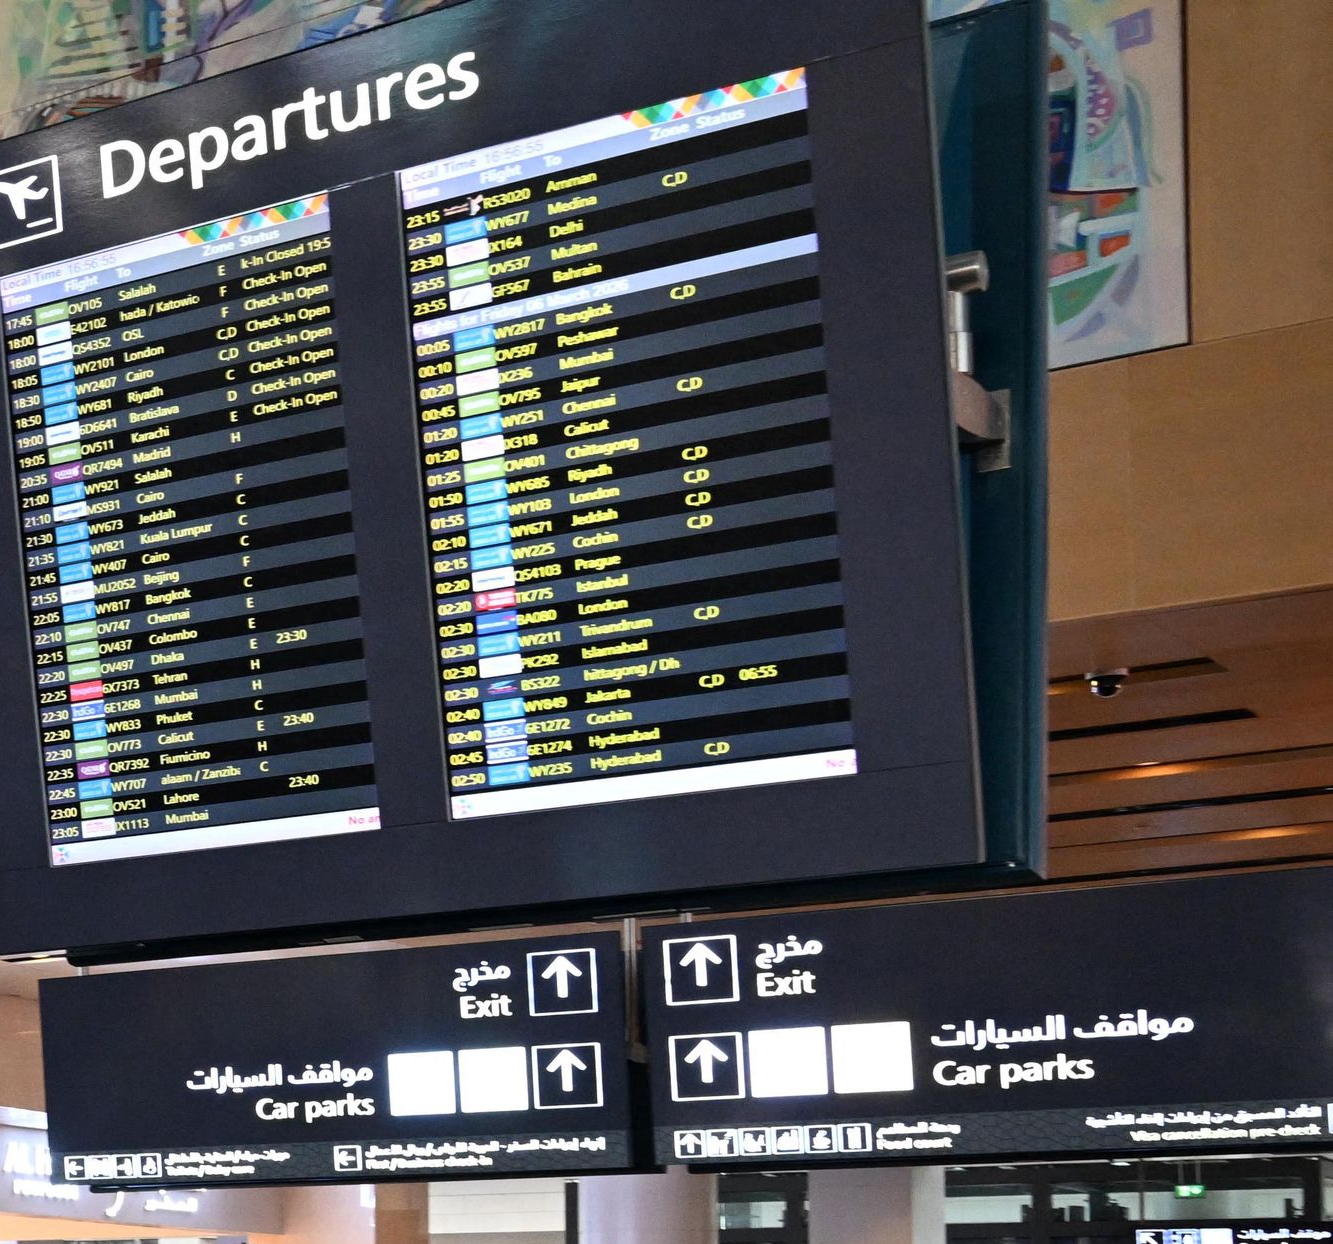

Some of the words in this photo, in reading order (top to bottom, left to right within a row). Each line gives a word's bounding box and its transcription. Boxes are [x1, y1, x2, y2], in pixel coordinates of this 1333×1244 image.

[100, 51, 480, 199] Departures
[63, 273, 98, 294] Flight
[116, 265, 131, 280] To
[202, 238, 235, 258] Zone
[238, 227, 280, 249] Status
[11, 374, 38, 389] 18:05
[73, 356, 114, 374] WY2101
[123, 346, 164, 362] London
[216, 326, 237, 340] C,D
[245, 312, 296, 331] Check-In
[297, 305, 330, 320] Open
[19, 453, 45, 468] 19:05
[80, 438, 113, 455] OV511
[130, 425, 169, 443] Karachi
[229, 410, 238, 422] E
[252, 397, 303, 415] Check-In
[304, 390, 337, 405] Open
[28, 552, 54, 567] 21:35
[89, 539, 124, 554] WY821
[139, 530, 169, 544] Kuala
[170, 523, 212, 538] Lumpur
[238, 514, 247, 525] C
[36, 650, 63, 664] 22:15
[98, 639, 132, 654] OV437
[148, 628, 197, 644] Colombo
[247, 617, 255, 628] E
[42, 709, 69, 723] 22:30
[104, 698, 141, 713] 6E1268
[154, 688, 198, 705] Mumbai
[251, 679, 262, 690] H
[45, 748, 72, 761] 22:30
[107, 738, 141, 752] OV773
[157, 731, 194, 744] Calicut
[256, 720, 265, 731] E
[283, 712, 314, 726] 23:40
[756, 935, 823, 969] مخرج
[452, 961, 512, 995] مخرج
[757, 970, 816, 998] Exit
[459, 994, 513, 1020] Exit
[930, 1015, 1066, 1050] السيارات
[1074, 1009, 1195, 1042] مواقف
[186, 1064, 283, 1095] السيارات
[287, 1060, 373, 1087] مواقف
[932, 1060, 991, 1087] Car
[1000, 1054, 1095, 1089] parks
[255, 1098, 299, 1121] Car
[305, 1093, 376, 1125] parks
